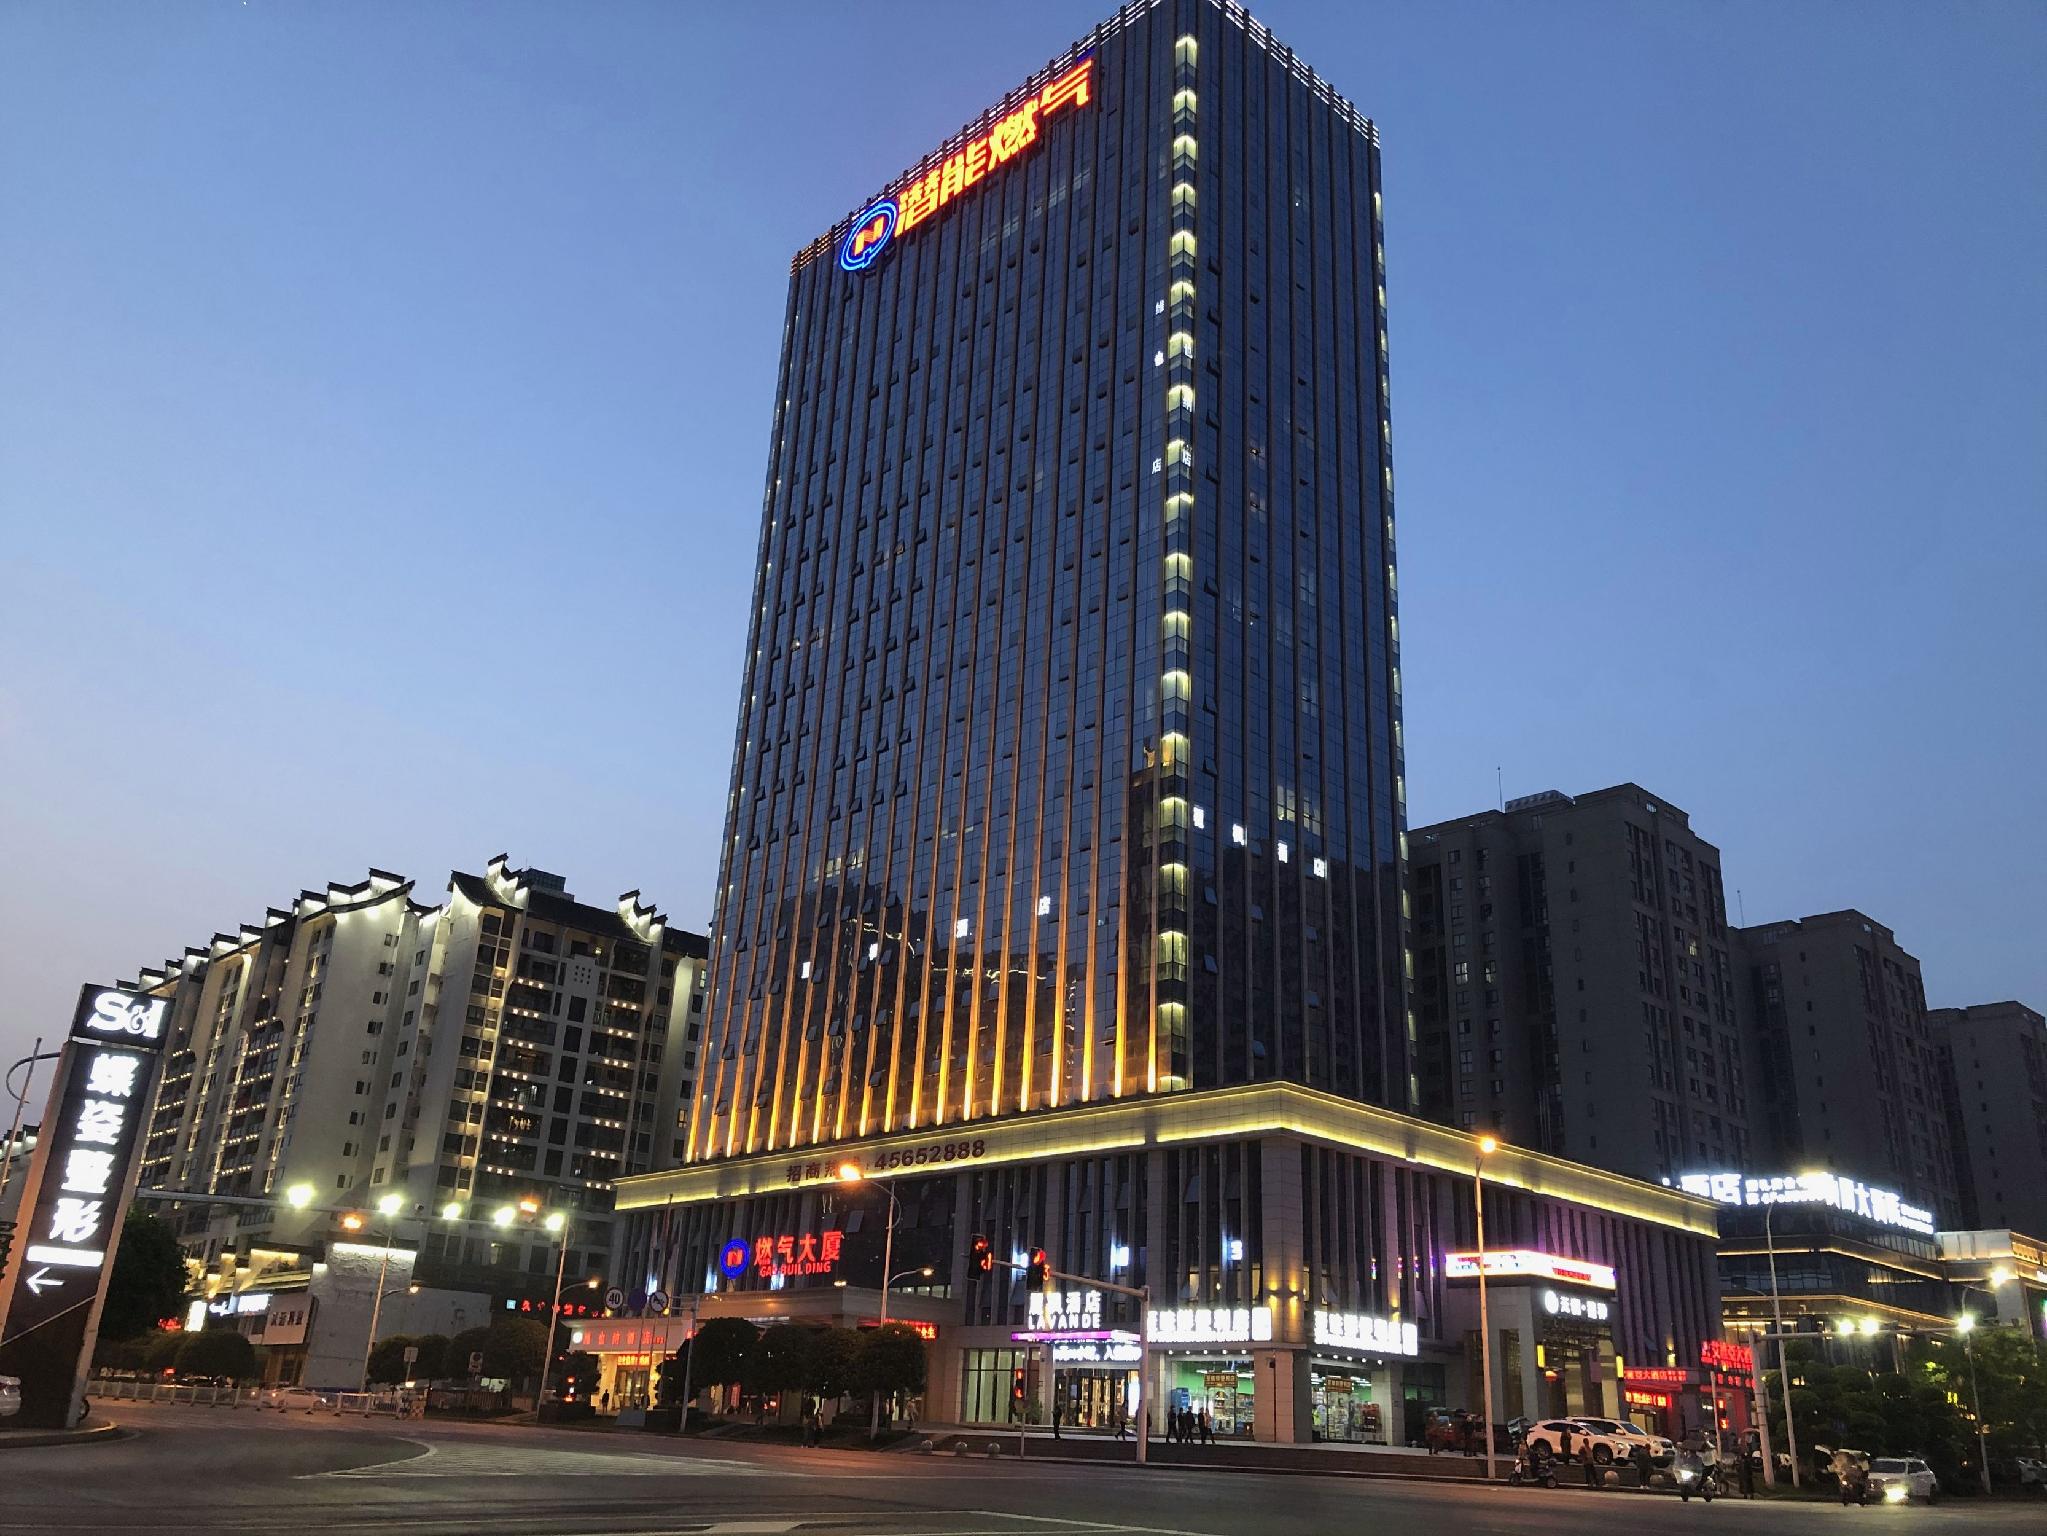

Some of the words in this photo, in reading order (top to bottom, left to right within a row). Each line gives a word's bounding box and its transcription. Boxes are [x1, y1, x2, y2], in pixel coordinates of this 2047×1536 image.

[875, 1139, 985, 1171] 45652888
[754, 1230, 842, 1266] 燃气大厦
[609, 1293, 621, 1306] 40
[1028, 1314, 1101, 1330] LAVANDE
